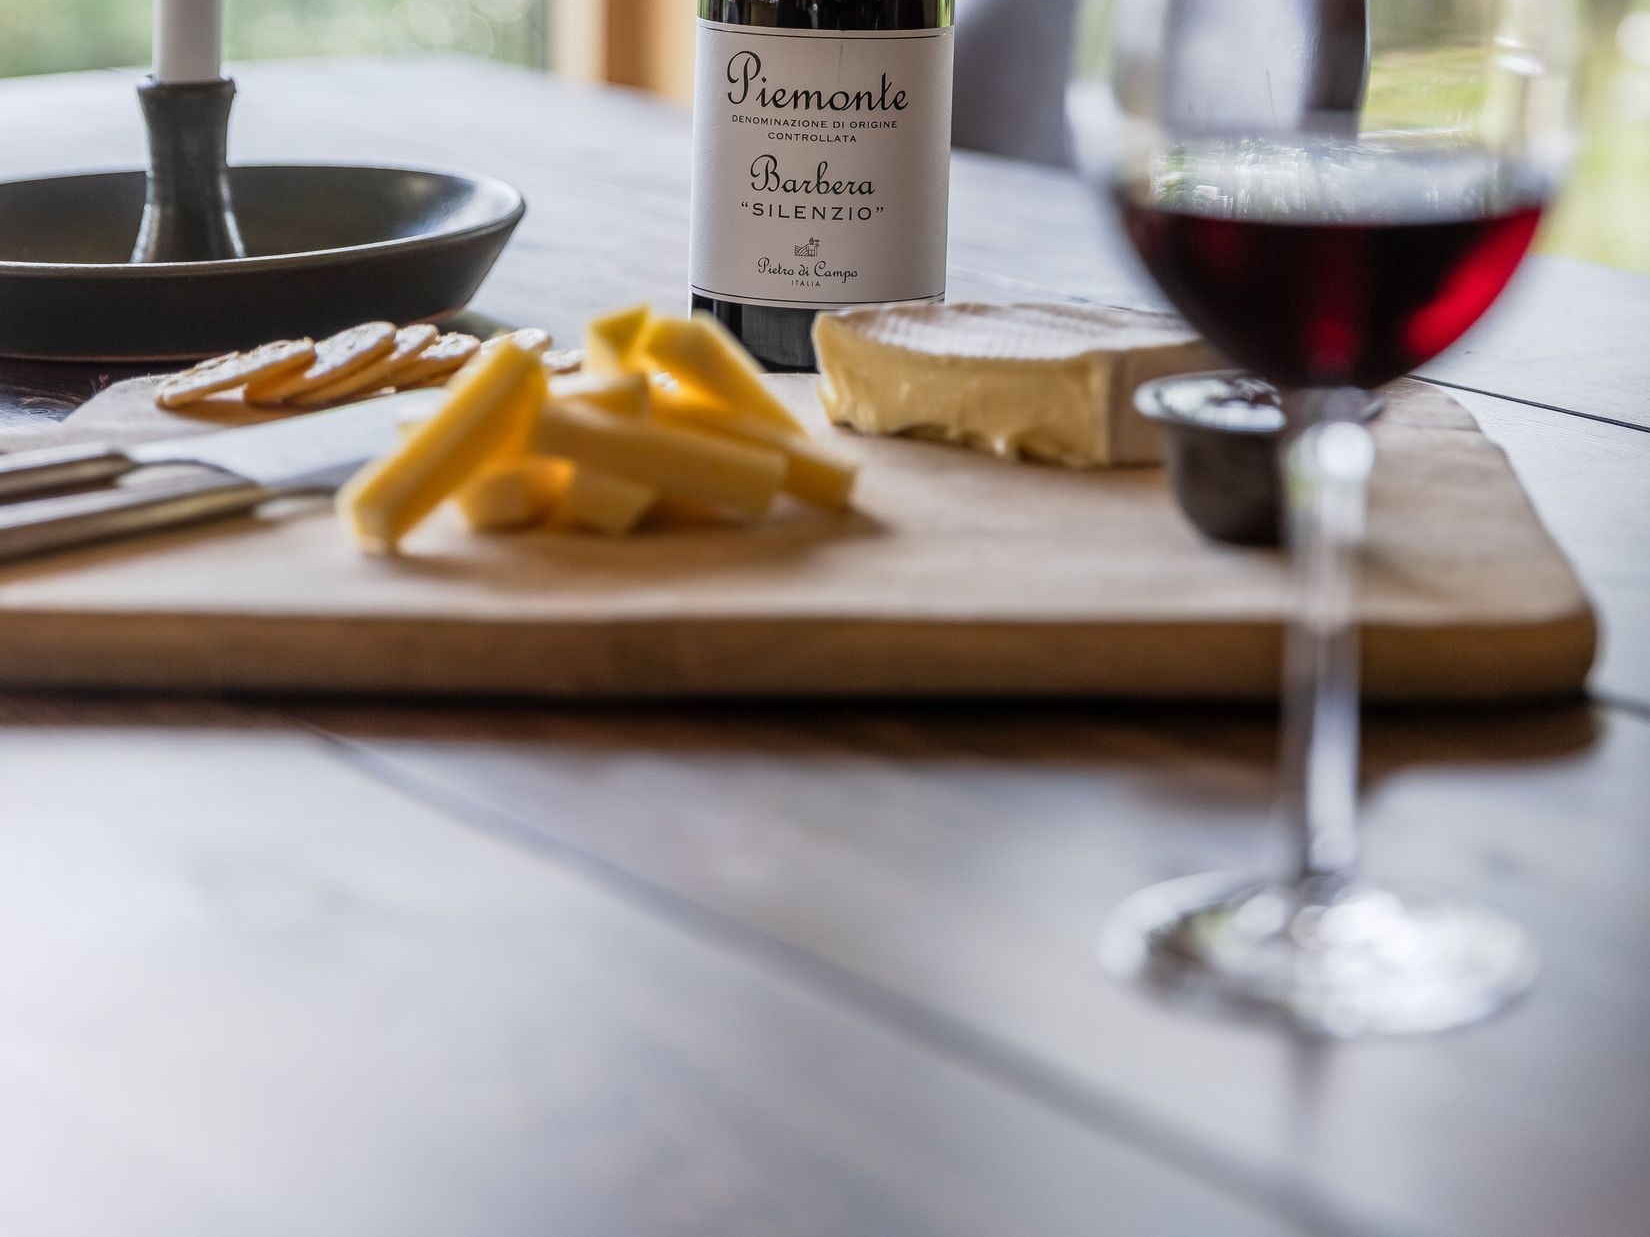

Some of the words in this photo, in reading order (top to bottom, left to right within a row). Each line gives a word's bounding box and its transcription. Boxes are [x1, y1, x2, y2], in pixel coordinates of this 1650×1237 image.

[727, 50, 908, 111] Piemonte
[732, 115, 827, 128] DENOMINAZIONE
[833, 120, 845, 128] DI
[850, 121, 897, 129] ORIGINE
[768, 132, 857, 142] CONTROLLATA
[750, 154, 875, 195] Barbera
[757, 257, 794, 276] Pietro
[798, 264, 809, 277] di
[814, 261, 858, 283] Campo
